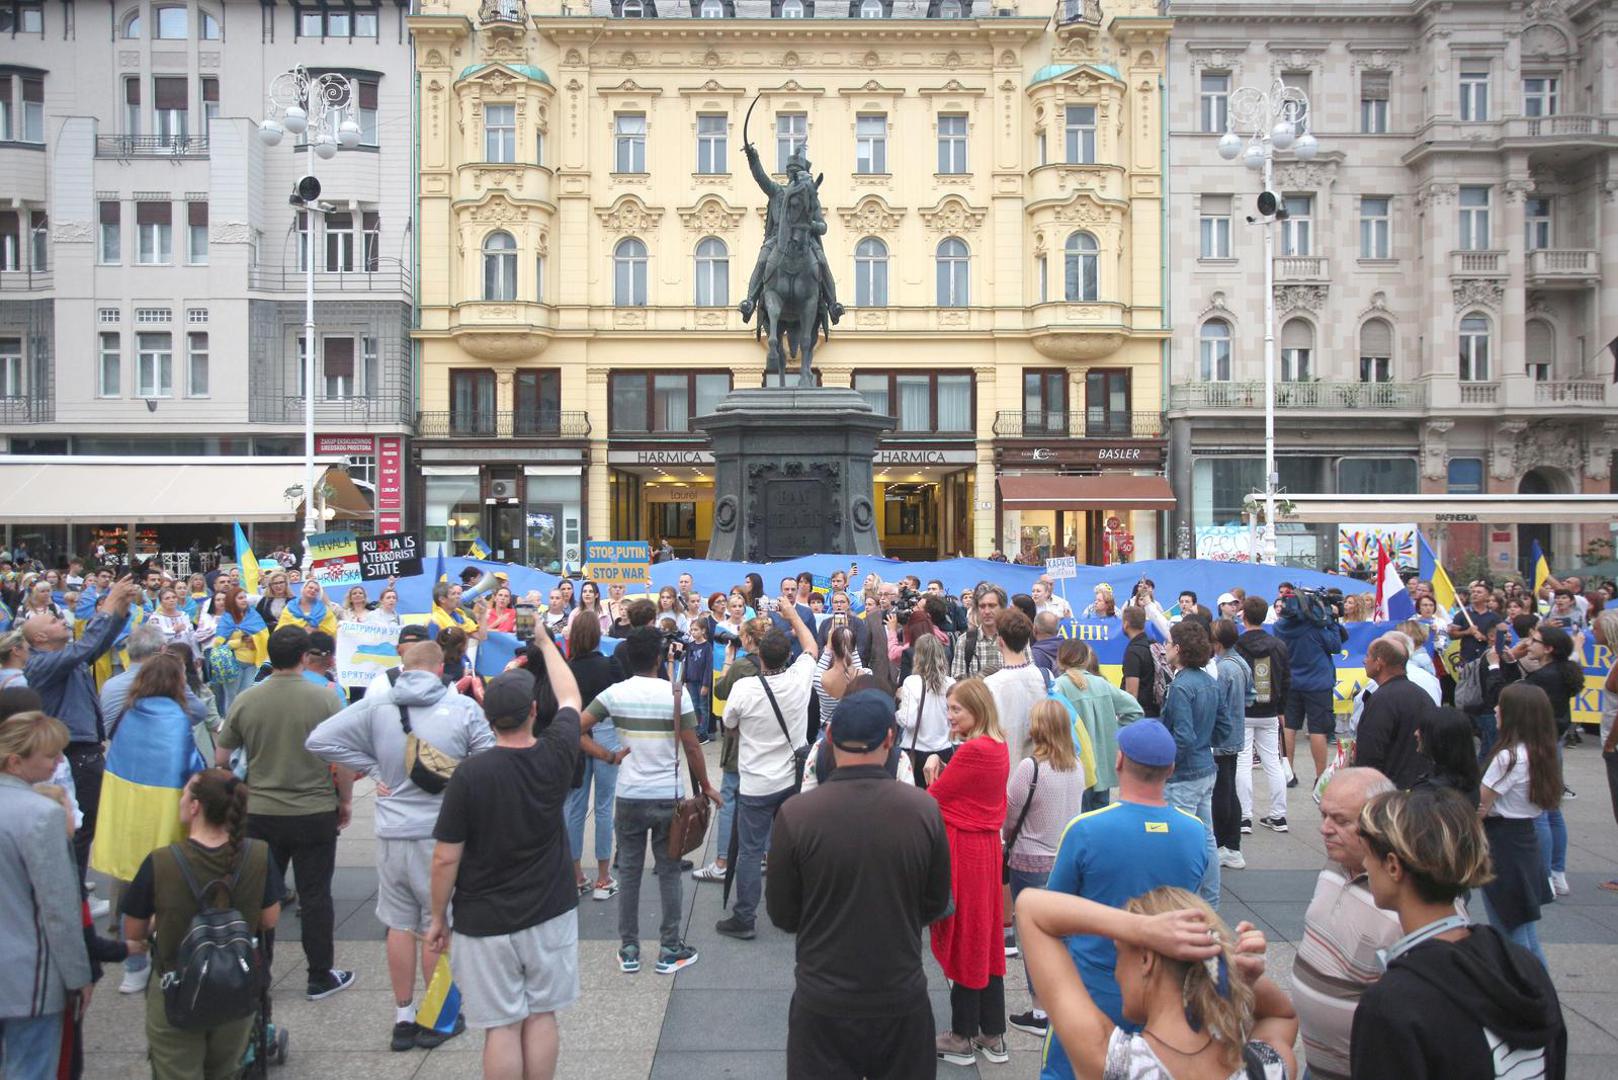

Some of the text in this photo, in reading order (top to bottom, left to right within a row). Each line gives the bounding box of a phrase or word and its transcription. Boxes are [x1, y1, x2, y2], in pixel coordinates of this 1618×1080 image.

[638, 451, 703, 464] HARMICA
[881, 451, 946, 463] HARMICA
[1098, 448, 1140, 459] BASLER
[319, 536, 351, 552] HVALA
[362, 535, 416, 552] RUSSIA IS
[362, 549, 415, 564] A TERRORIST
[589, 546, 646, 559] STOP PUTIN
[317, 568, 360, 583] HRVATSKA
[367, 561, 400, 576] STATE
[593, 567, 644, 579] STOP WAR
[1057, 620, 1109, 640] АЇНІ!
